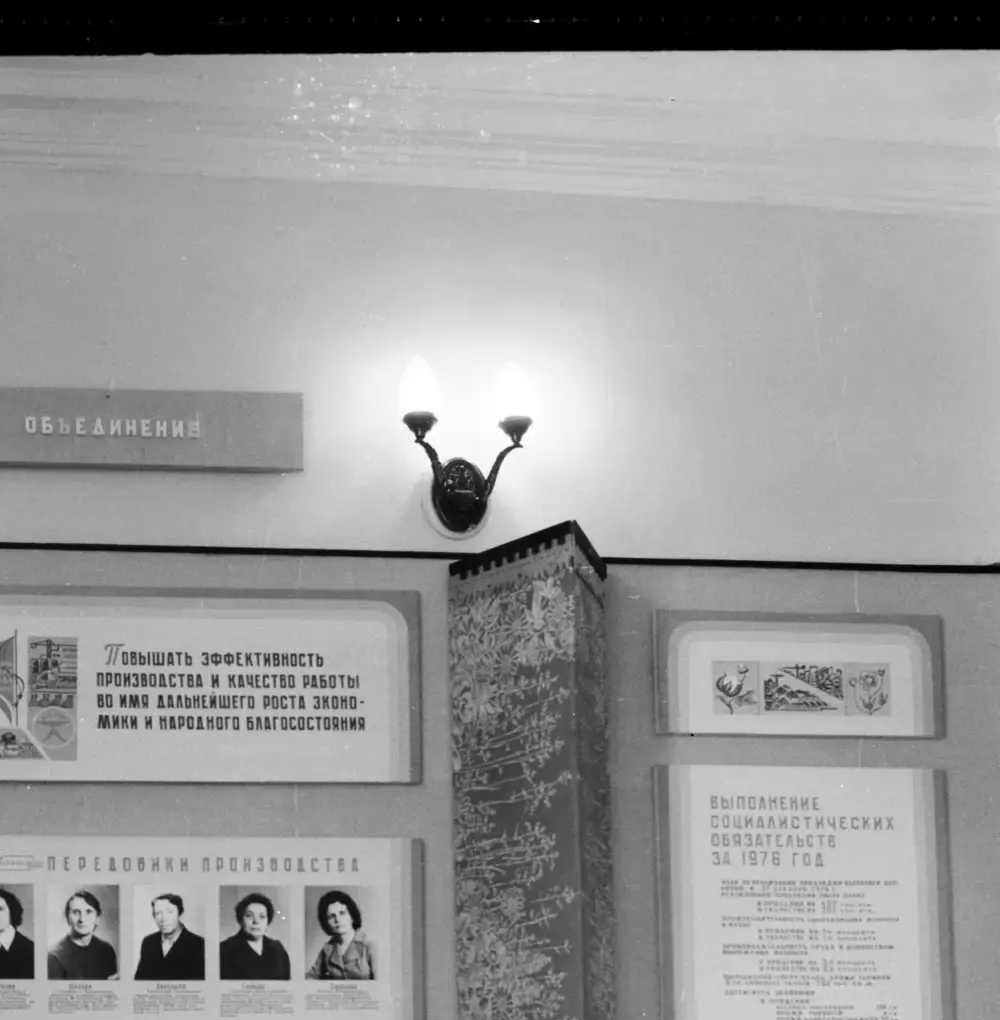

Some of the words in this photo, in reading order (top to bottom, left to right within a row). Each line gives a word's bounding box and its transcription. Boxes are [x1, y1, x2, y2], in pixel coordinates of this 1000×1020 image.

[24, 415, 200, 439] ОБЪЕДИНЕНИЕ
[201, 651, 324, 668] ЭФФЕКТИВНОСТЬ
[96, 672, 203, 688] ПРОИЗВОДСТВА
[211, 674, 220, 688] И
[227, 673, 296, 689] КАЧЕСТВО
[303, 674, 360, 689] РАБОТЫ
[97, 693, 113, 709] ВО
[119, 693, 149, 709] ИМЯ
[157, 691, 255, 709] ДАЛЬНЕЙШЕГО
[263, 695, 306, 710] РОСТА
[313, 695, 365, 710] ЭКОНО-
[97, 714, 138, 730] МИКИ
[144, 715, 153, 730] И
[159, 715, 240, 731] НАРОДНОГО
[246, 716, 366, 731] БЛАГОСОСТОЯНИЯ
[709, 795, 821, 811] ВЫПОЛНЕНИЕ
[710, 815, 895, 831] СОЦИАЛИСТИЧЕСКИХ
[710, 833, 837, 848] ОБЯЗАТЕЛЬСТВ
[47, 857, 190, 873] ПЕРЕДОВИКИ
[202, 857, 361, 873] ПРОИЗВОДСТВА
[712, 851, 731, 866] ЗА
[742, 851, 781, 866] 1976
[792, 852, 825, 867] ГОД
